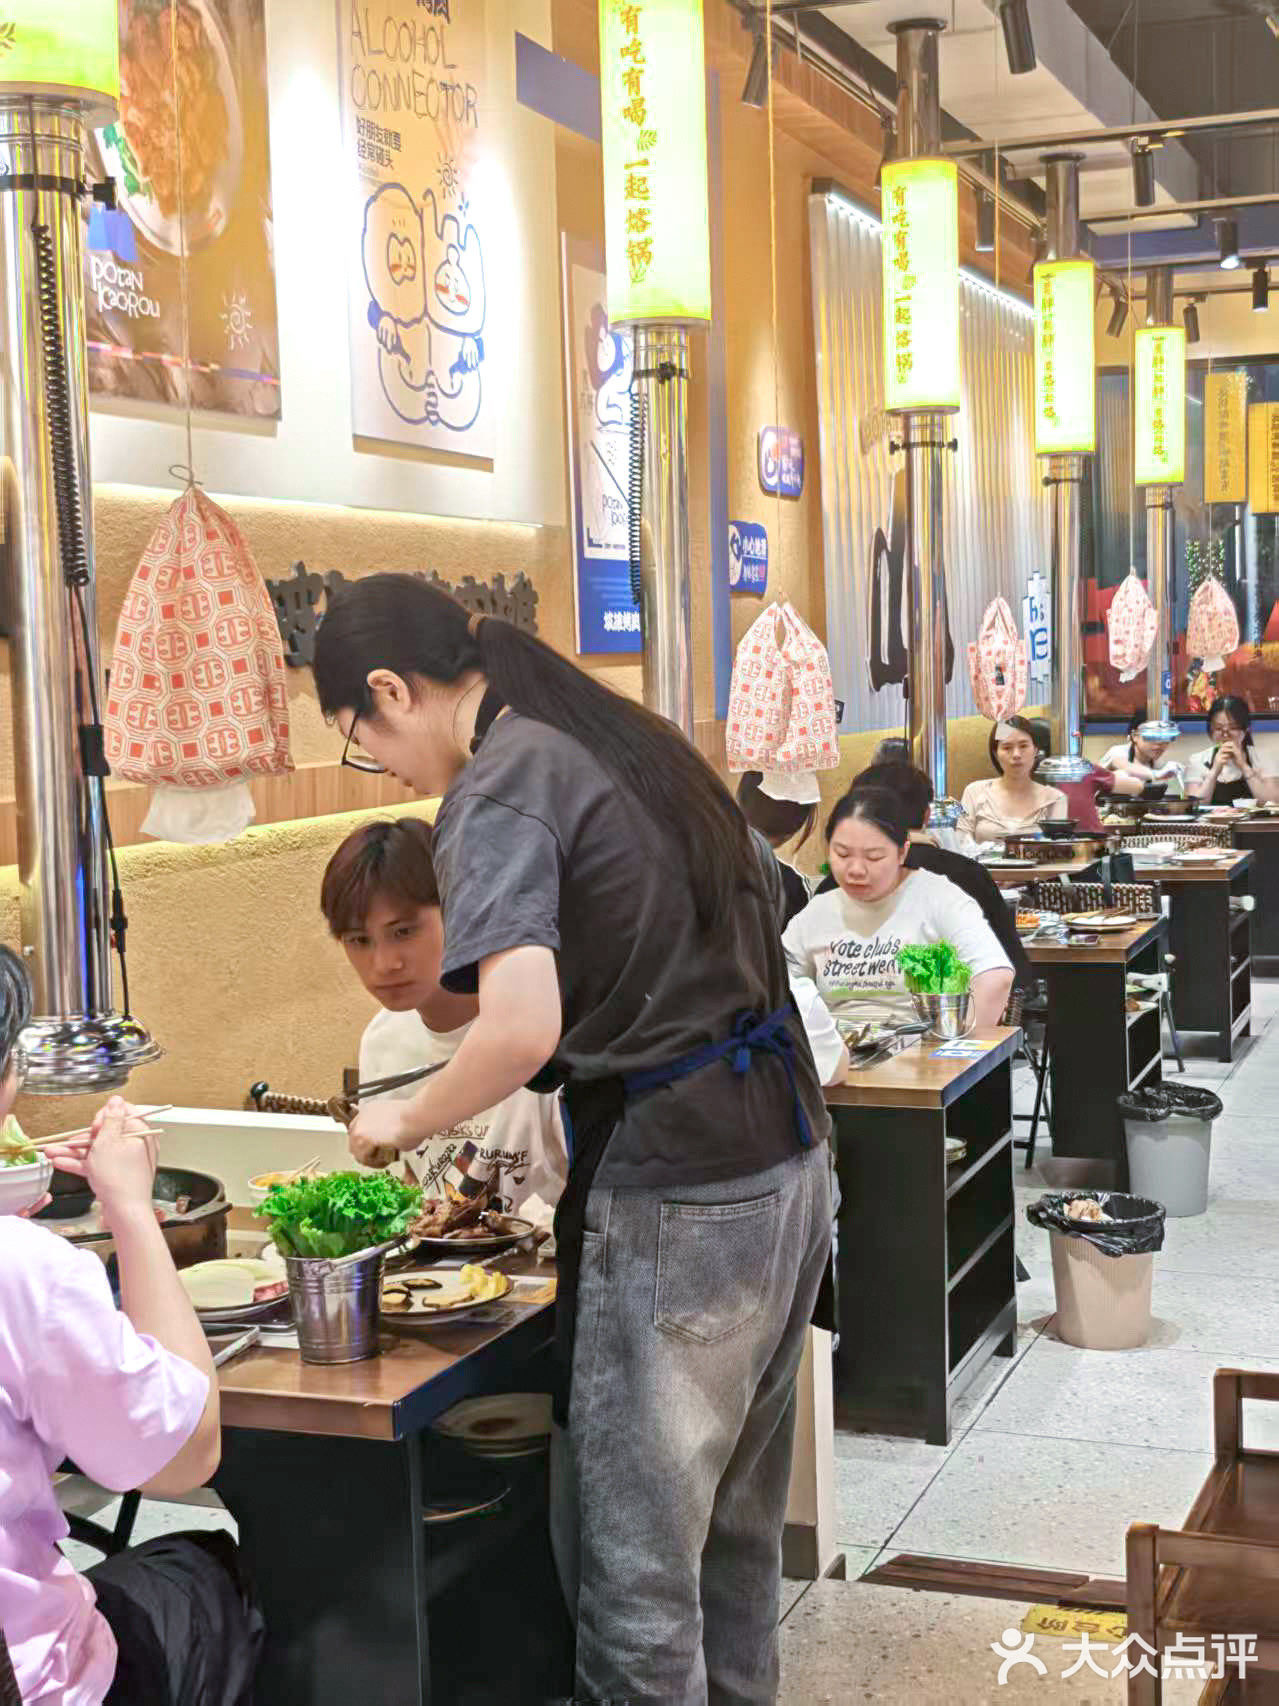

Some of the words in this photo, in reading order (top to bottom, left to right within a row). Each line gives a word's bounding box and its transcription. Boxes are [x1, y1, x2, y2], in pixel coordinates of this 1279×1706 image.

[351, 63, 479, 129] CONNECTOR
[619, 4, 647, 127] 有吃有喝
